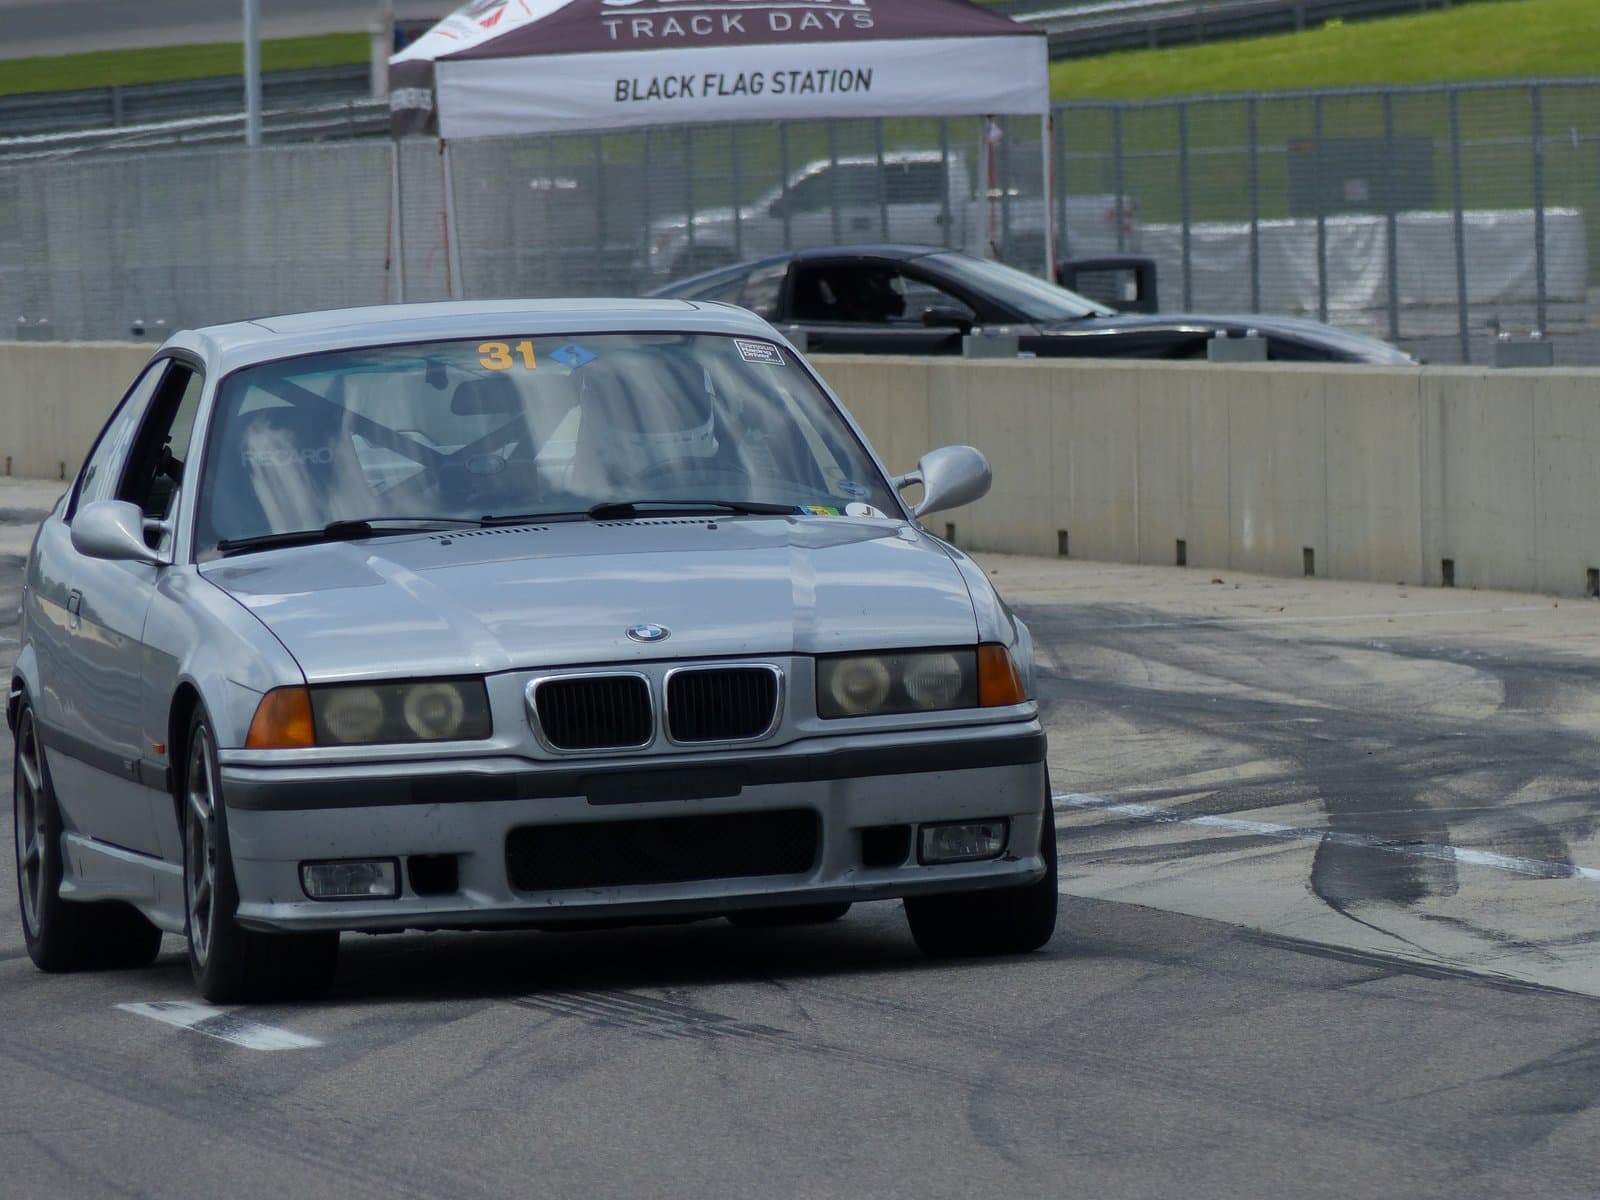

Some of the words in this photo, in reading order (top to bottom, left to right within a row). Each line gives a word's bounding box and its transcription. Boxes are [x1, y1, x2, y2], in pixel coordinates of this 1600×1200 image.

[602, 13, 746, 40] TRACK
[768, 11, 875, 32] DAYS
[615, 74, 696, 102] BLACK
[703, 71, 765, 97] FLAG
[771, 67, 873, 95] STATION
[478, 340, 537, 370] 31
